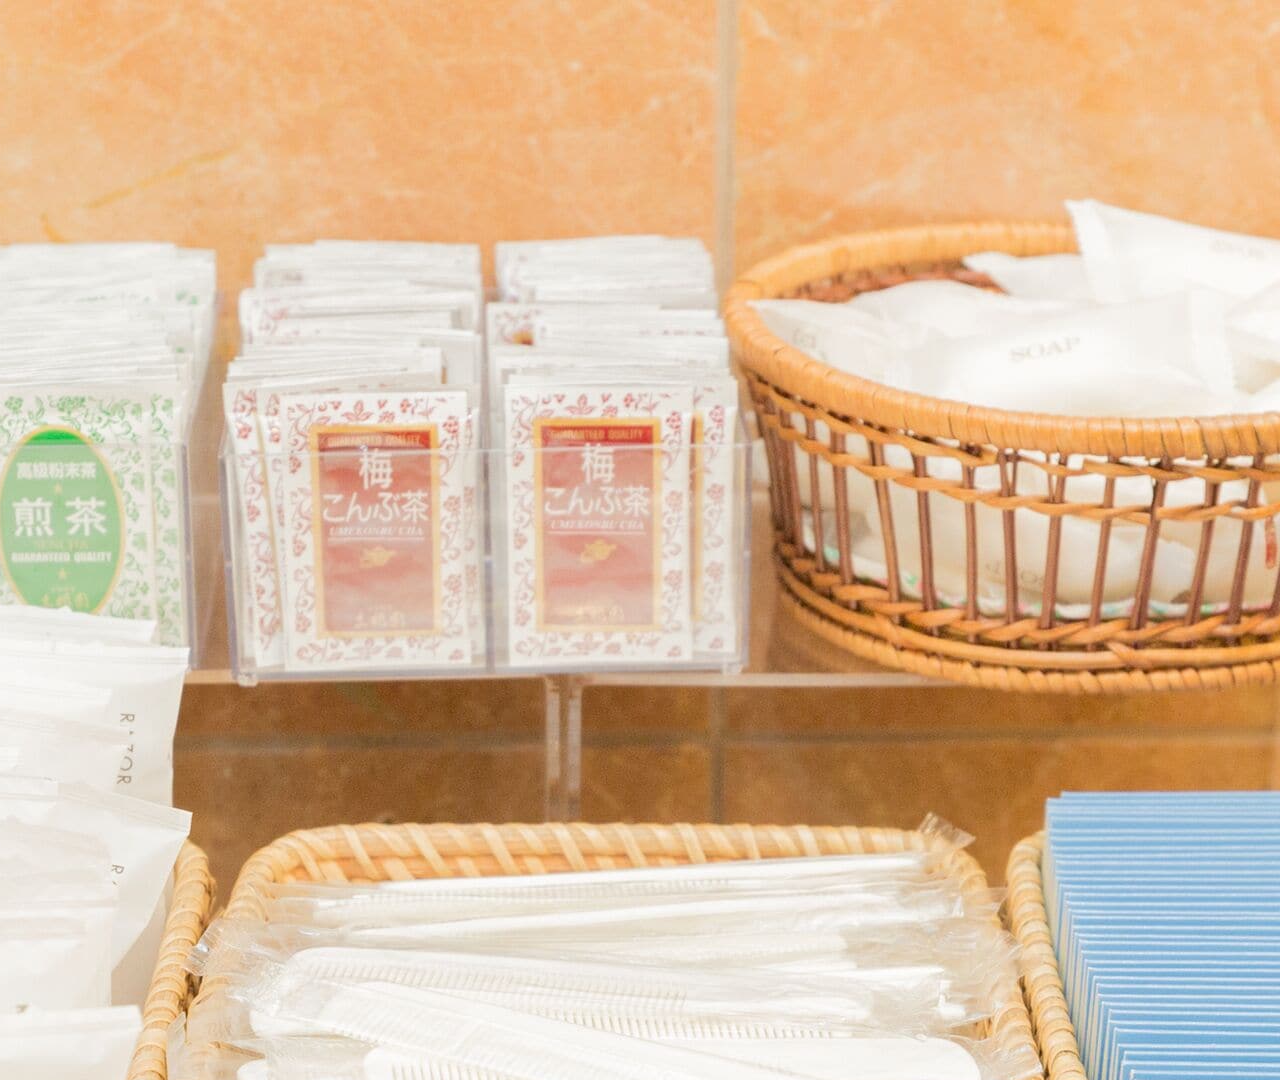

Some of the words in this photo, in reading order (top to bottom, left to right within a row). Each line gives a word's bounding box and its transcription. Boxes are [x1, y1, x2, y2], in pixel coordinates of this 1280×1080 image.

[1008, 335, 1082, 364] SOAP
[359, 445, 393, 491] 梅
[581, 442, 615, 485] 梅
[11, 496, 108, 537] 煎茶
[322, 489, 429, 523] こんぶ茶
[543, 485, 651, 518] こんぶ茶
